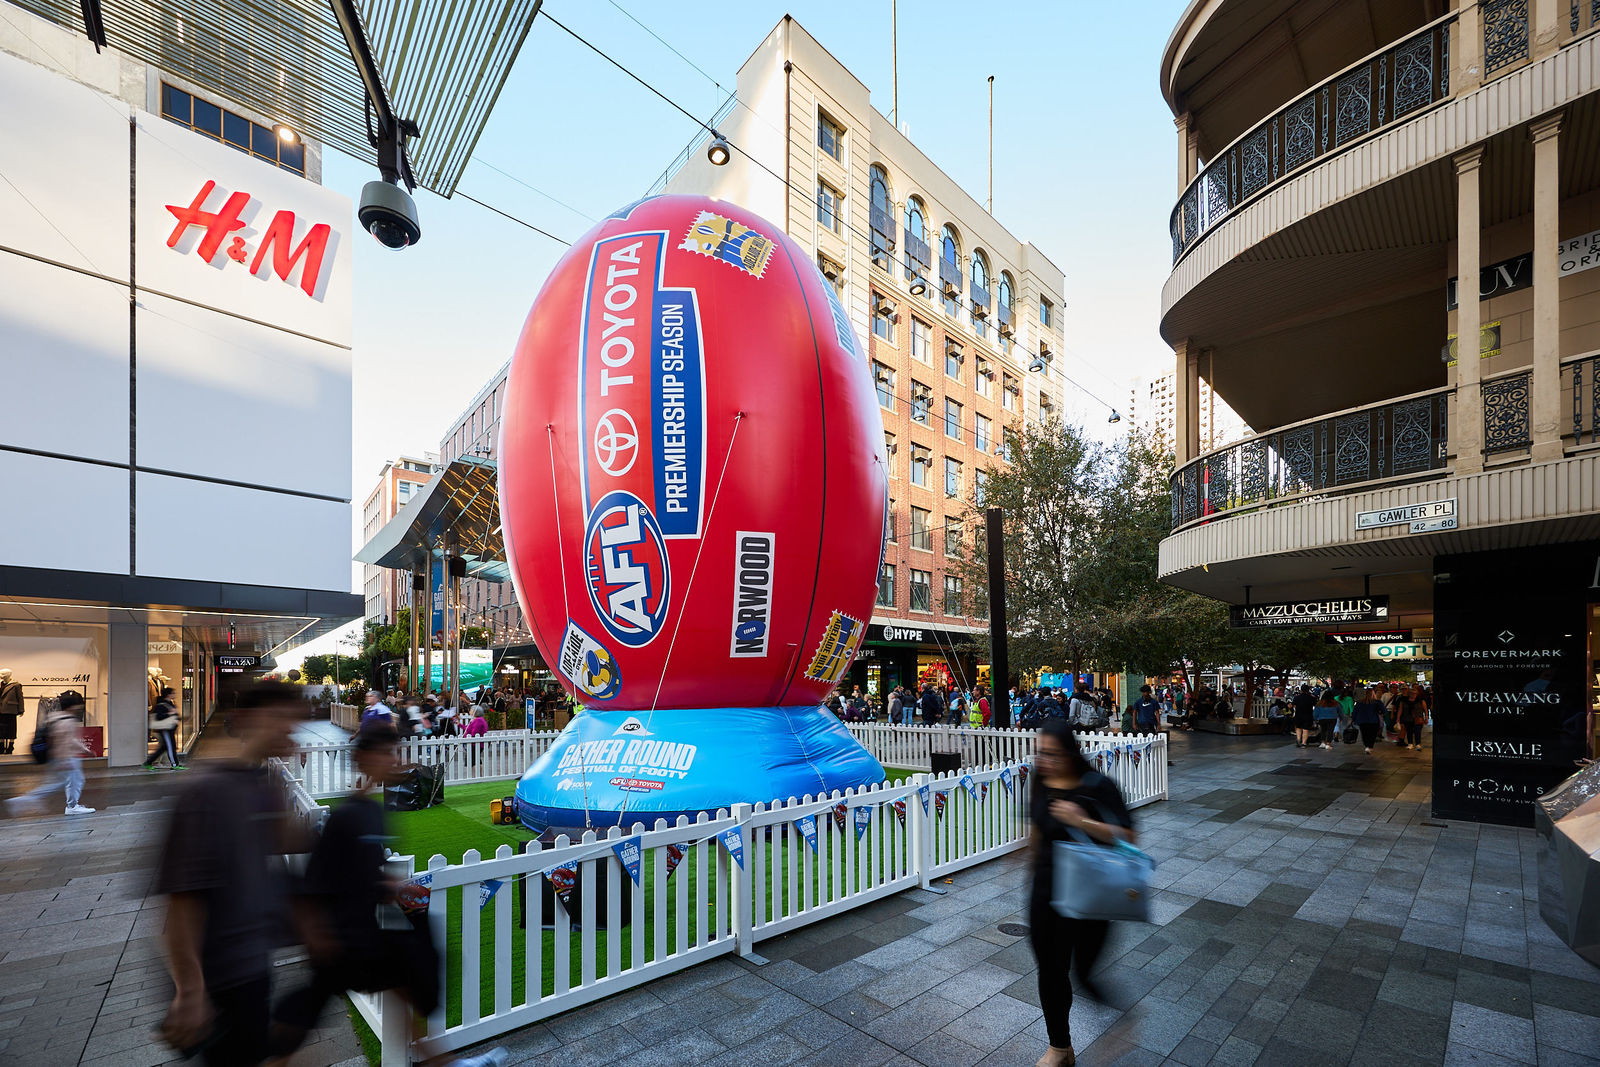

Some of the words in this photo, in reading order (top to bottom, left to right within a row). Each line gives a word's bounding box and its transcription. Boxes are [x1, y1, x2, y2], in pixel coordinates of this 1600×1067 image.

[165, 180, 330, 297] H&M
[601, 241, 643, 396] TOYOTA
[662, 304, 685, 371] SEASON
[662, 374, 689, 513] PREMIERSHIP
[1379, 506, 1427, 522] GAWLER
[1434, 503, 1451, 515] PL
[1414, 523, 1426, 531] 42
[1441, 519, 1454, 528] 80
[601, 503, 653, 633] AFL
[1243, 599, 1372, 619] MAZZUCCHELLI'S
[823, 618, 841, 654] ADELAIDE
[894, 628, 923, 641] HYPE
[1454, 649, 1561, 658] FOREVERMARK
[813, 655, 828, 674] HILLS
[1488, 706, 1525, 715] LOVE
[558, 740, 625, 768] GATHER
[621, 740, 697, 771] ROUND
[1470, 741, 1542, 756] ROYALE
[561, 764, 615, 776] FESTIVAL
[618, 765, 637, 774] OF
[638, 766, 688, 780] FOOTY
[621, 845, 638, 858] GATHER
